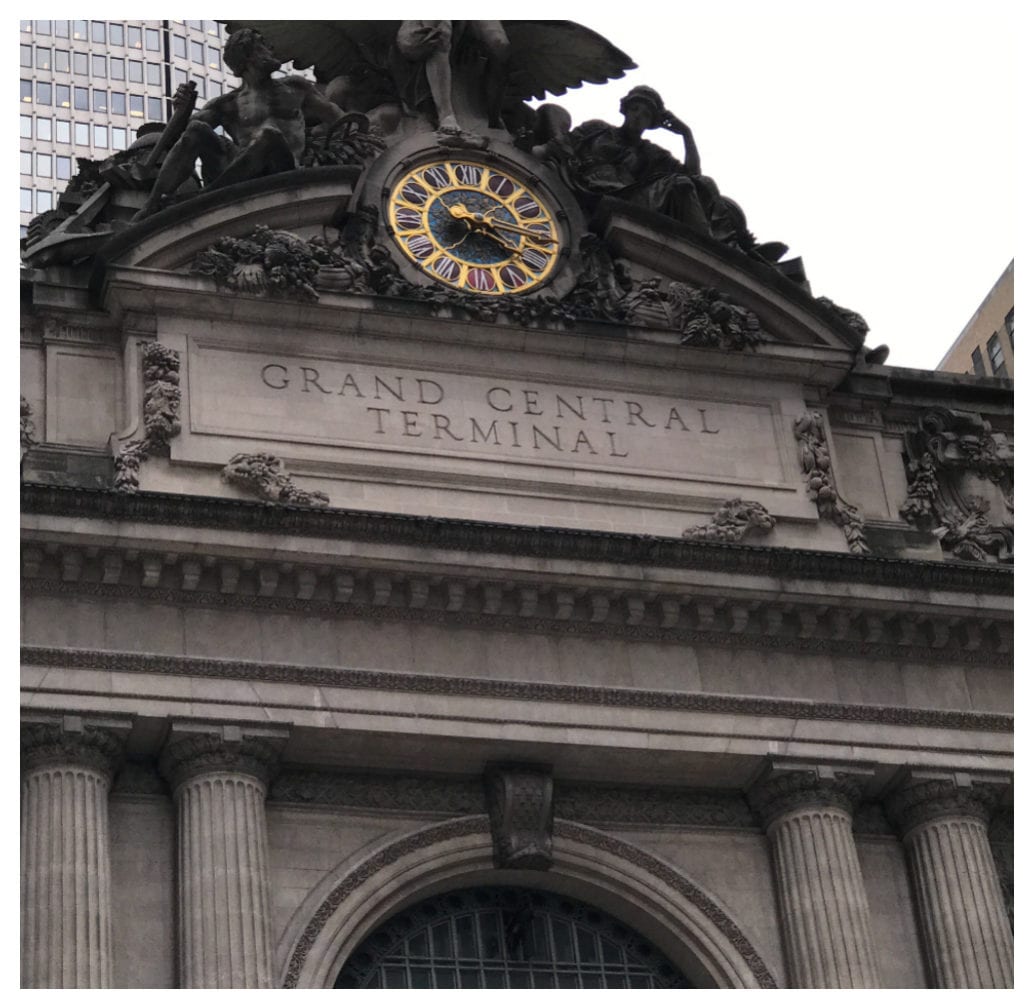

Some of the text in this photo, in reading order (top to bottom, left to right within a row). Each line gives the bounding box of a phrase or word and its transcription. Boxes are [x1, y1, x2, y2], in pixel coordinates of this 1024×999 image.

[260, 364, 721, 434] GRAND CENTRAL
[367, 406, 630, 458] TERMINAL
